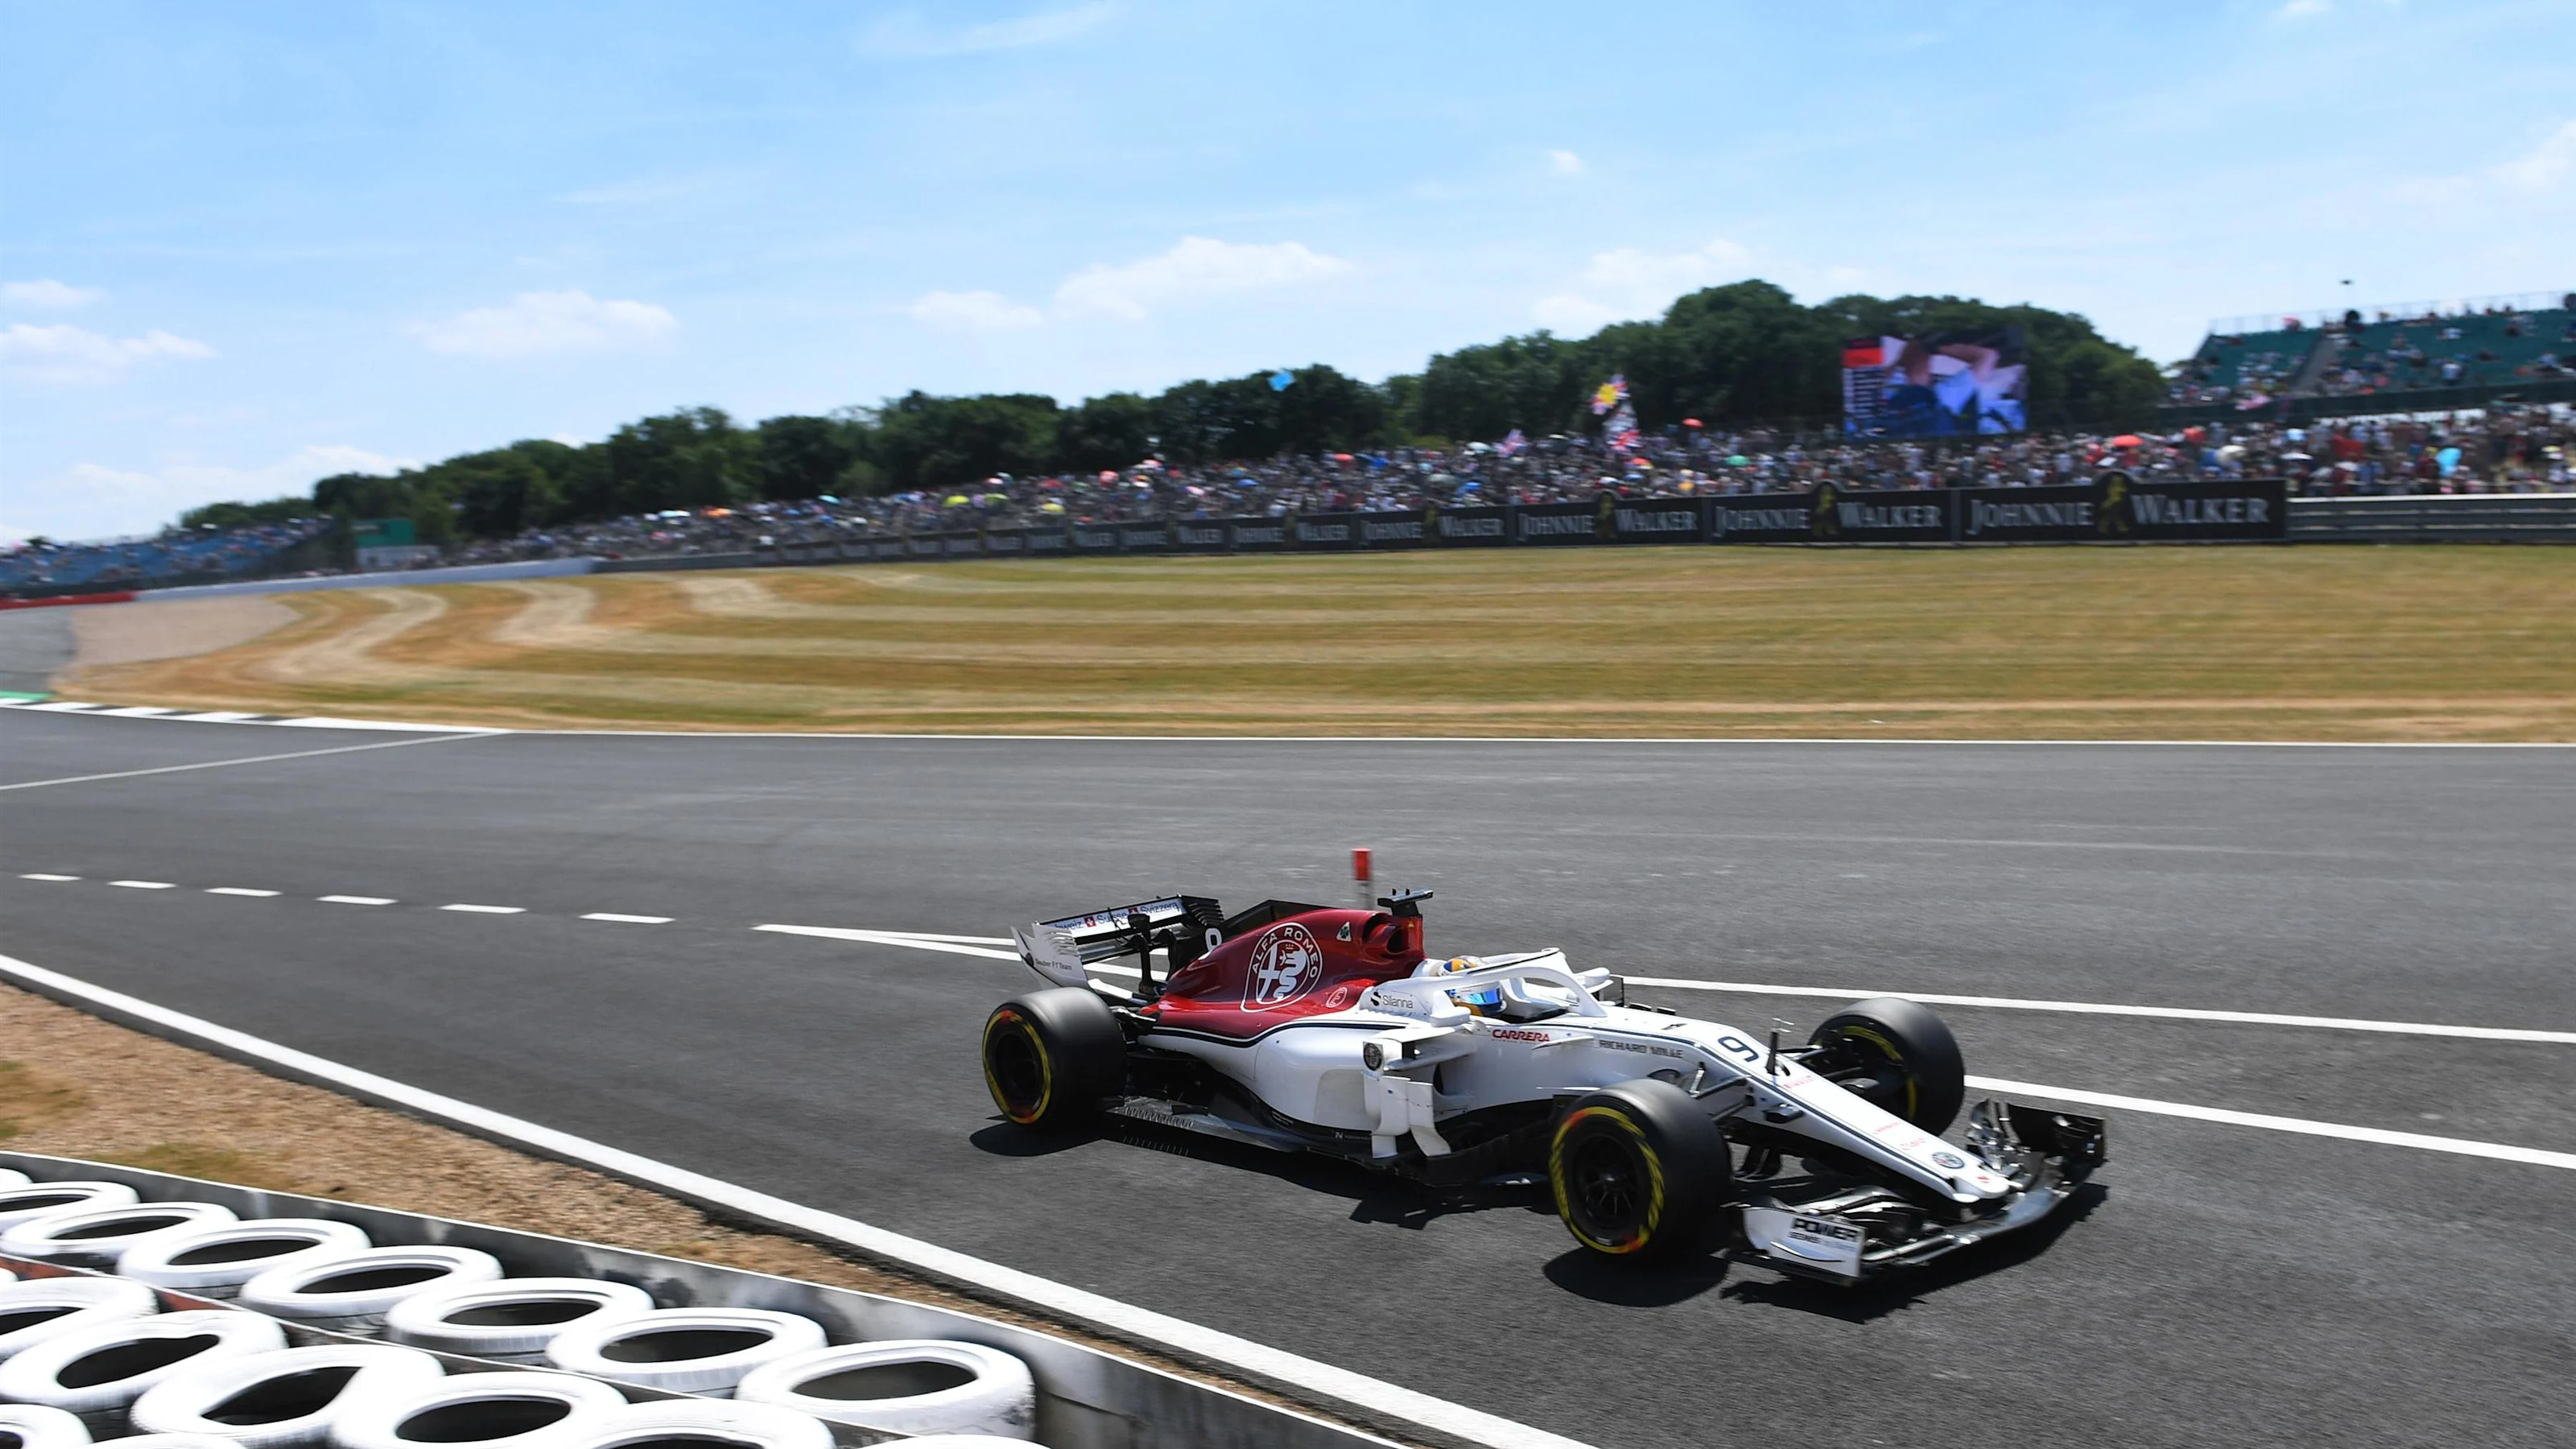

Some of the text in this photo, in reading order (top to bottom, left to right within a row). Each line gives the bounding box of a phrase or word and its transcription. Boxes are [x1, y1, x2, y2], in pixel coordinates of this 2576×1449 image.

[1615, 509, 1698, 532] WALKER
[1712, 502, 1942, 537] JOHNNIE WALKER
[1966, 494, 2270, 535] JOHNNIE WALKER
[1252, 927, 1319, 978] ALFA ROMEO
[1382, 994, 1413, 1009] Silanna
[1492, 1029, 1550, 1042] CARRERA
[1599, 1039, 1685, 1059] RICHARD MILLE
[1718, 1036, 1759, 1063] 9
[1790, 1217, 1859, 1242] POWER
